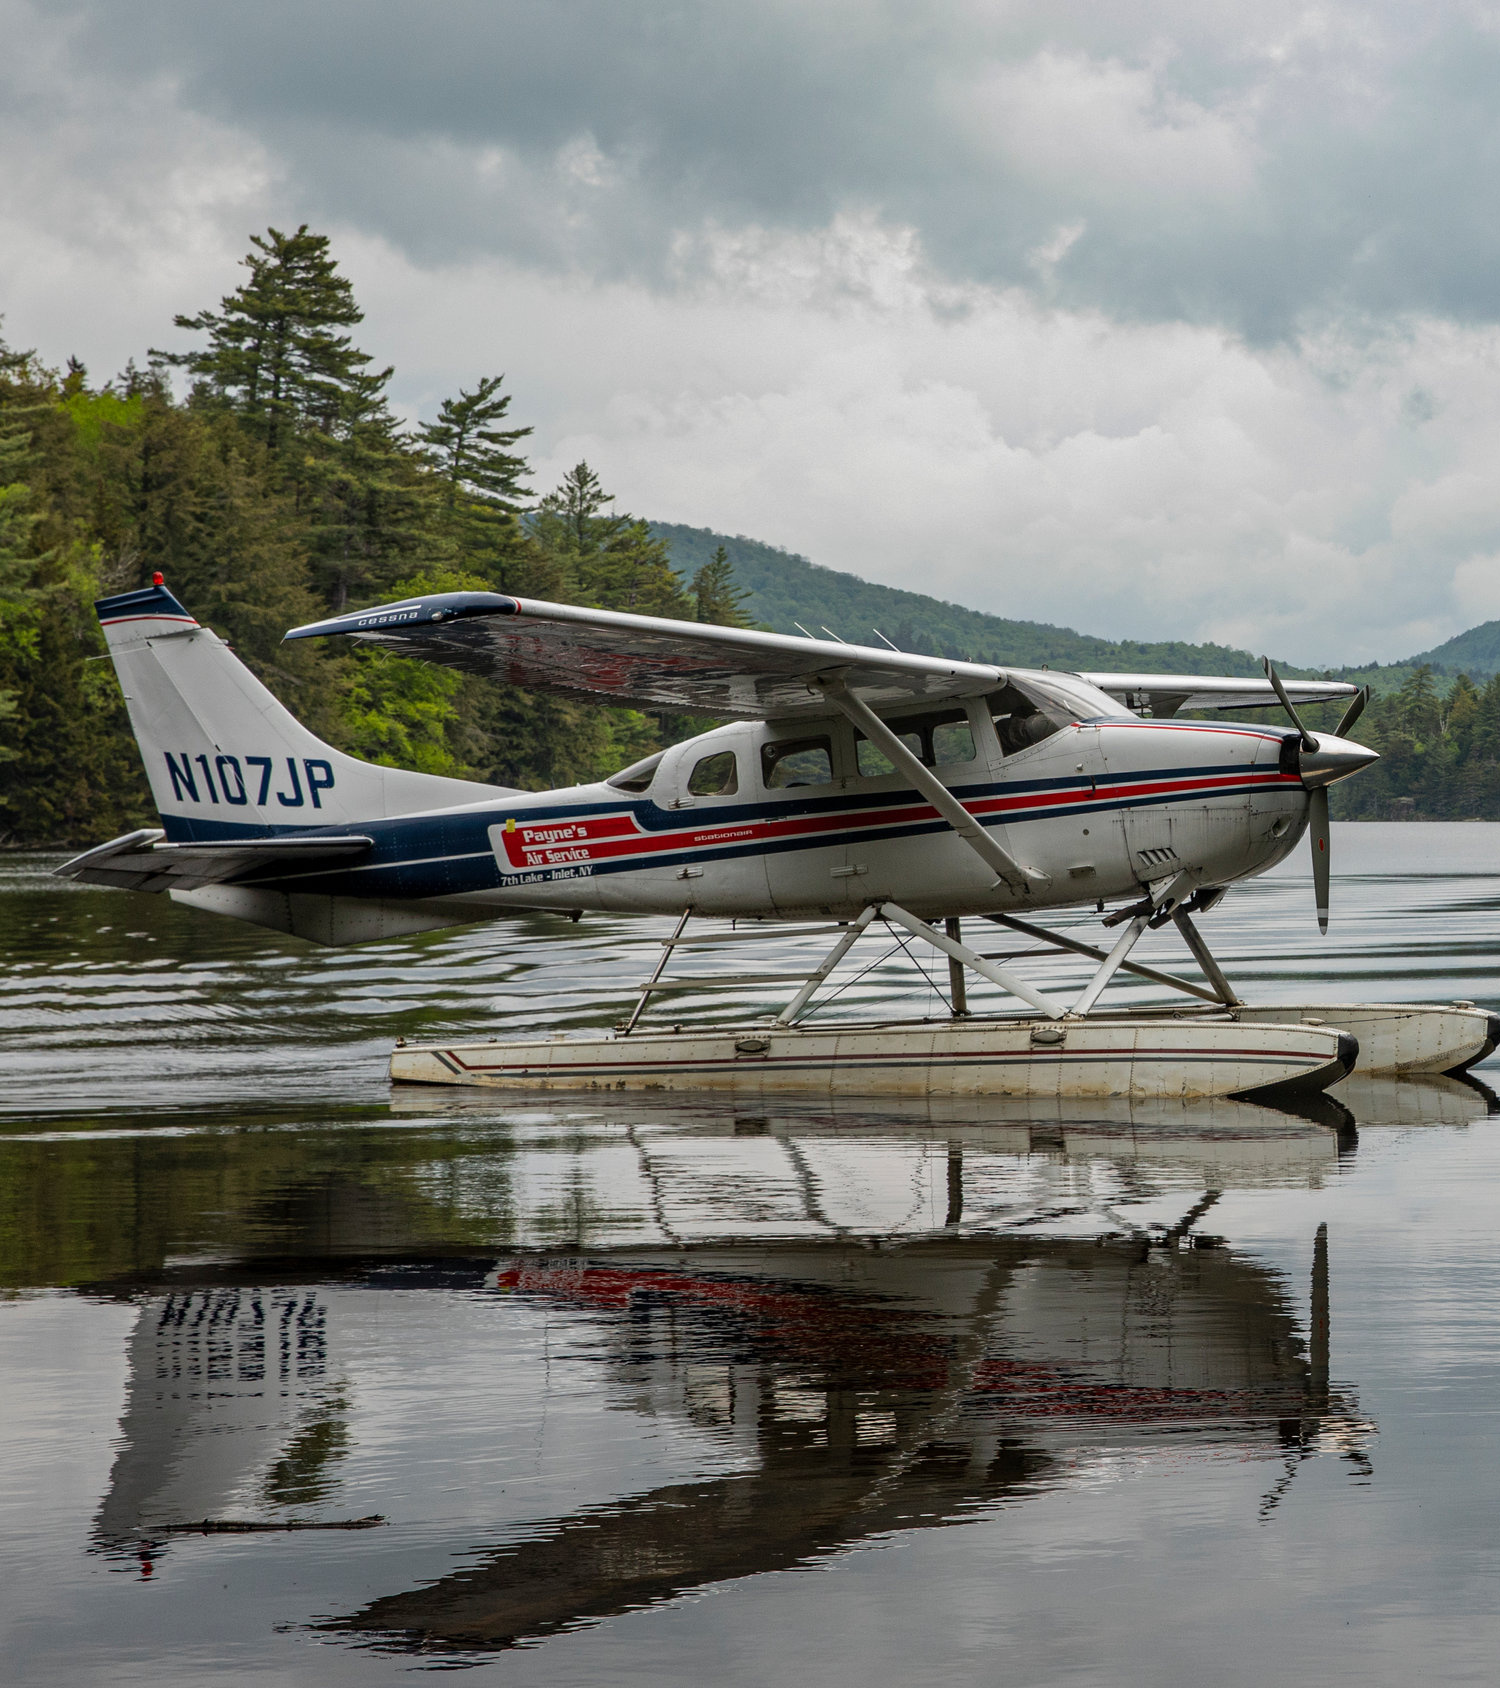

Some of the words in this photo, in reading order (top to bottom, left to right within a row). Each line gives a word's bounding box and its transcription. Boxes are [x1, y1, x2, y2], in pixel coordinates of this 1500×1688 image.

[358, 612, 418, 626] cessna
[164, 752, 335, 809] N107JP
[522, 825, 588, 843] Payne's
[526, 851, 544, 866] Air
[545, 848, 590, 863] Service
[501, 876, 519, 887] 7th
[520, 873, 544, 884] Lake
[580, 865, 593, 876] NY
